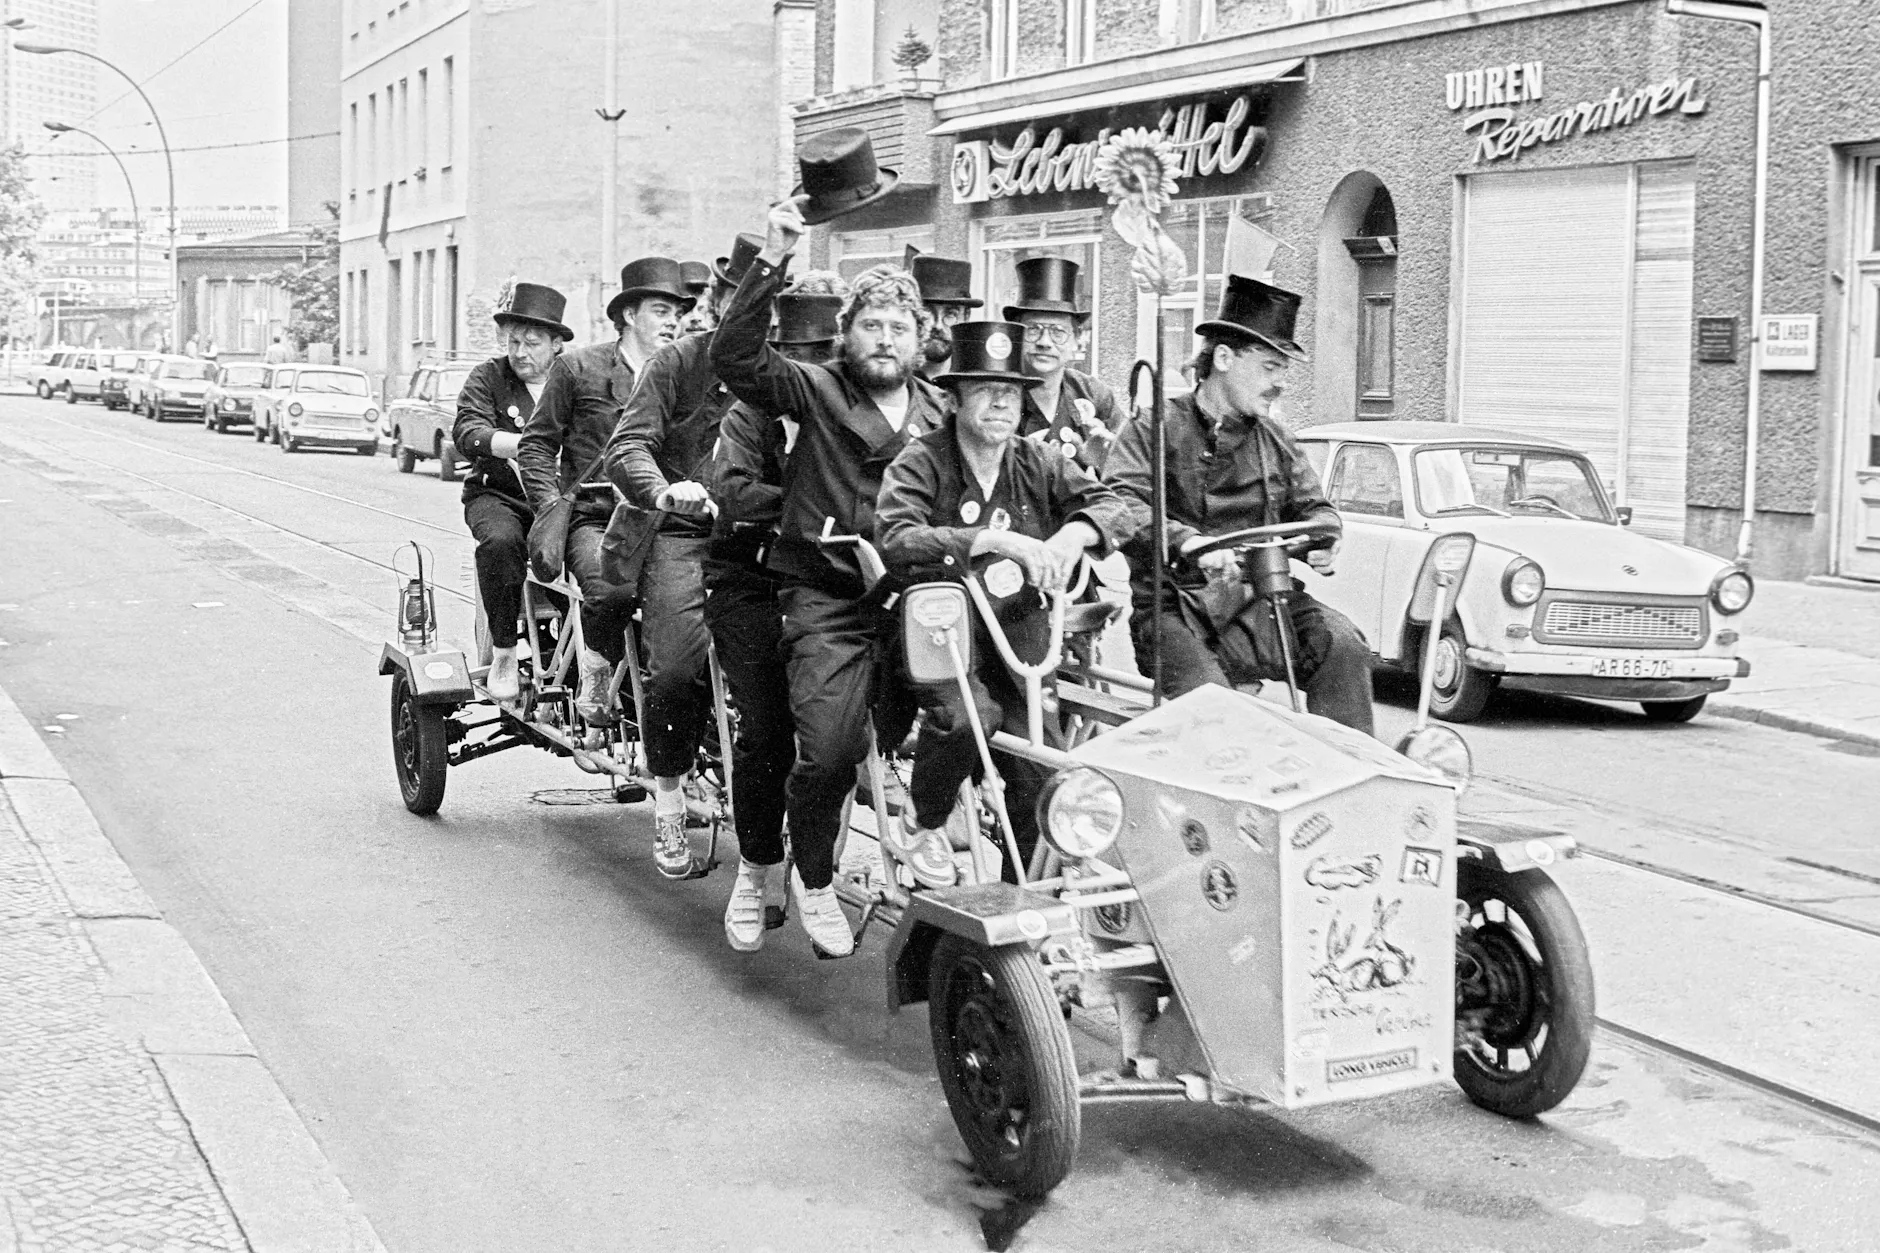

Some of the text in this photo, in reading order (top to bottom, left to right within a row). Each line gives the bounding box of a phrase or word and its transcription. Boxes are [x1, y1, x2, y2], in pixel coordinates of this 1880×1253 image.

[1445, 61, 1543, 110] UHREN
[1463, 78, 1707, 162] Reparaturen
[988, 96, 1268, 198] Lebenttel
